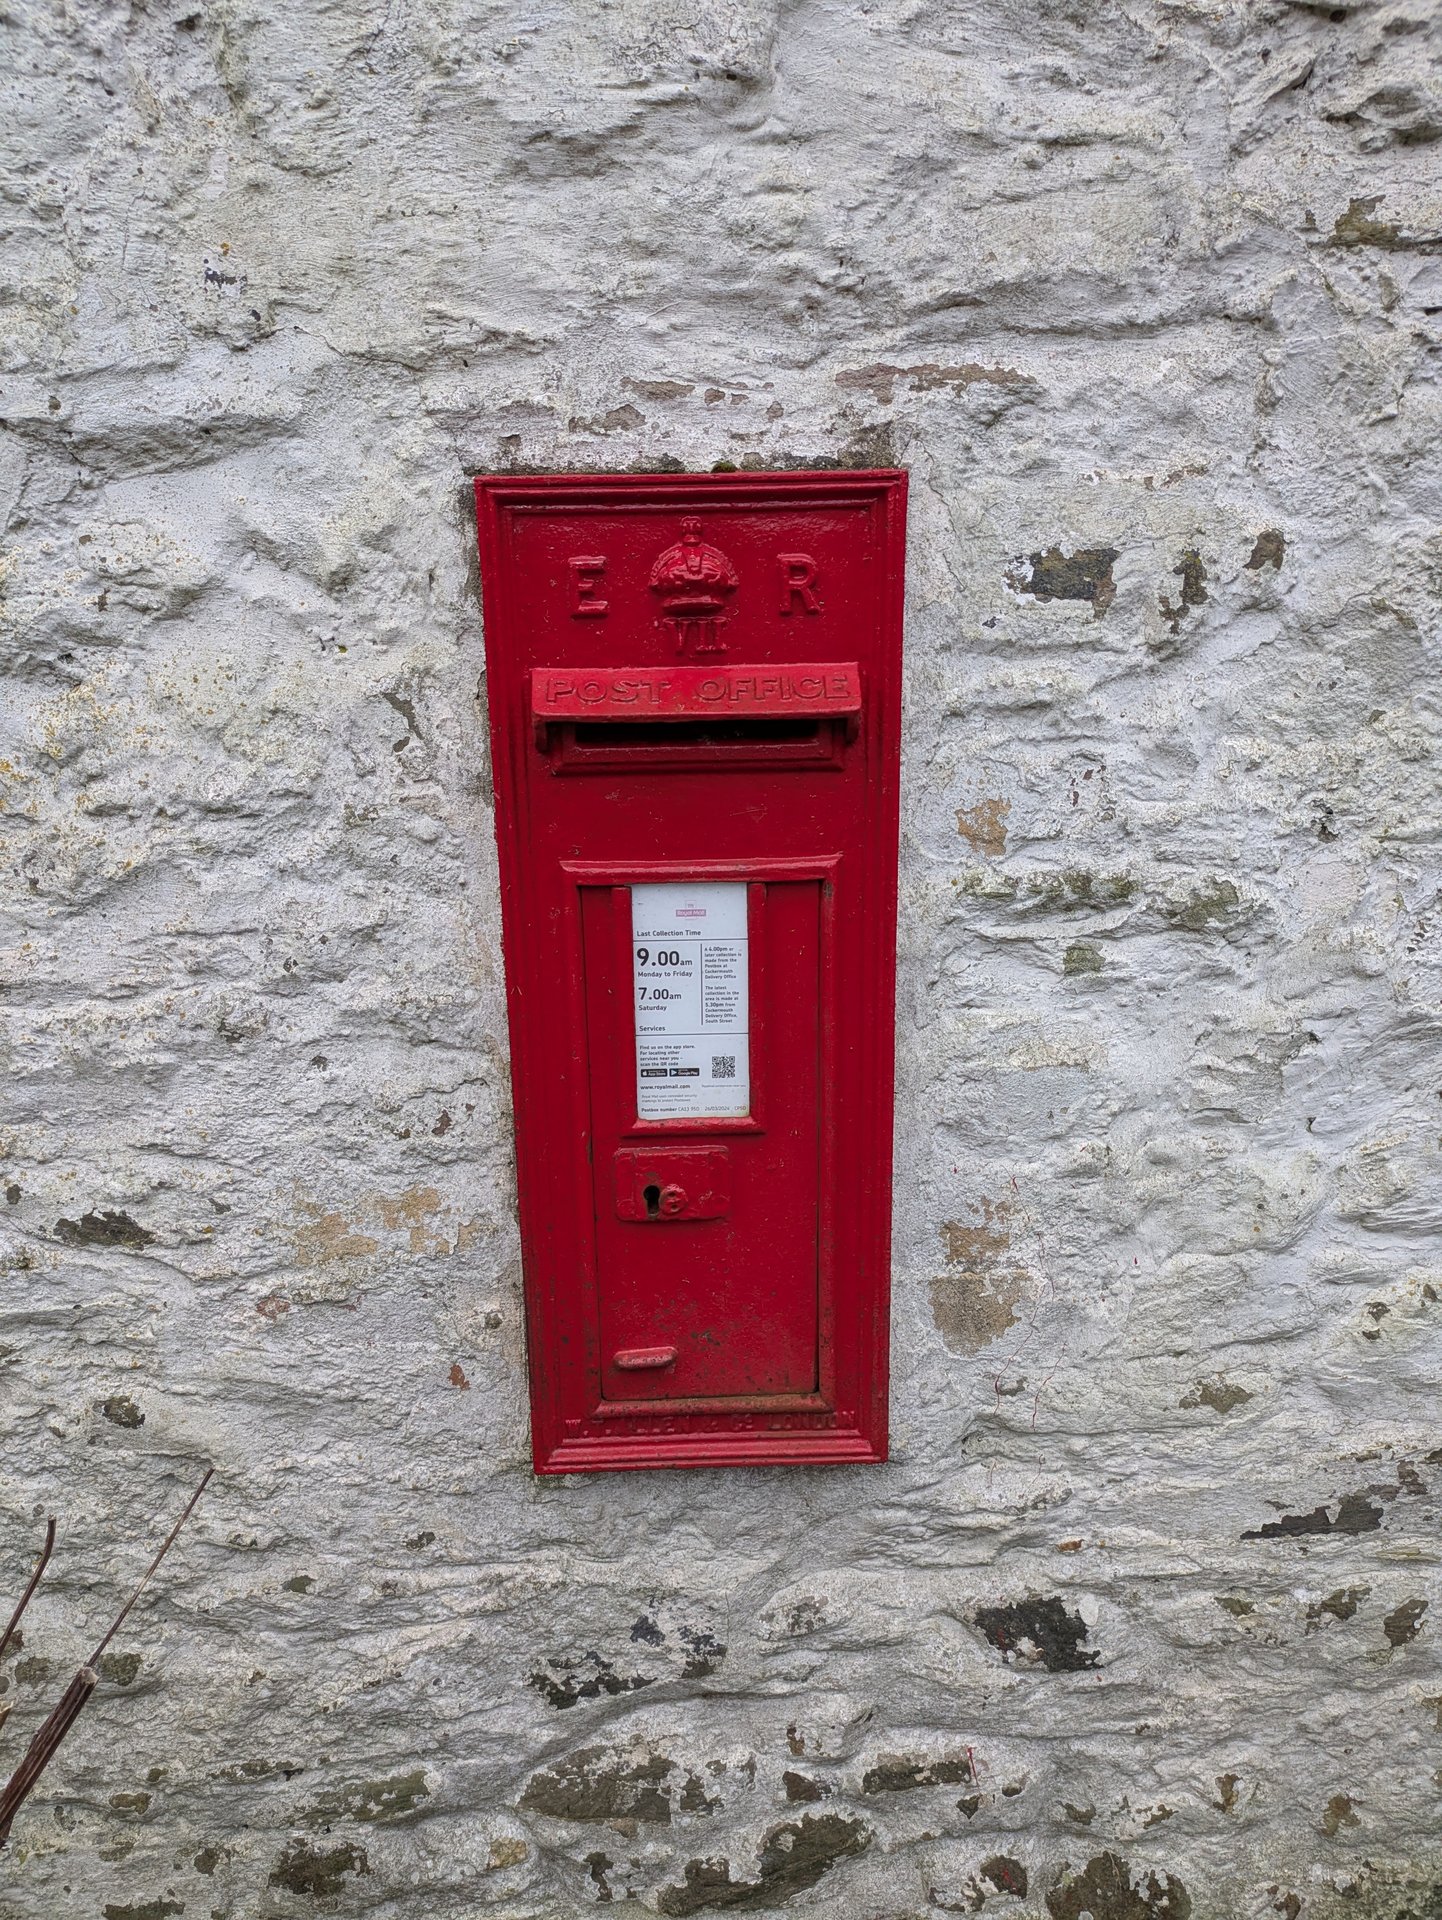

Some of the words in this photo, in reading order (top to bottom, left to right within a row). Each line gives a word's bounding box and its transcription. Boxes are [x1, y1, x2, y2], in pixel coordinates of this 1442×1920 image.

[568, 555, 610, 620] E
[776, 553, 822, 617] R
[545, 678, 672, 704] POST
[695, 674, 850, 701] OFFICE
[637, 948, 692, 966] 9.00am
[638, 987, 681, 1000] 7.00am
